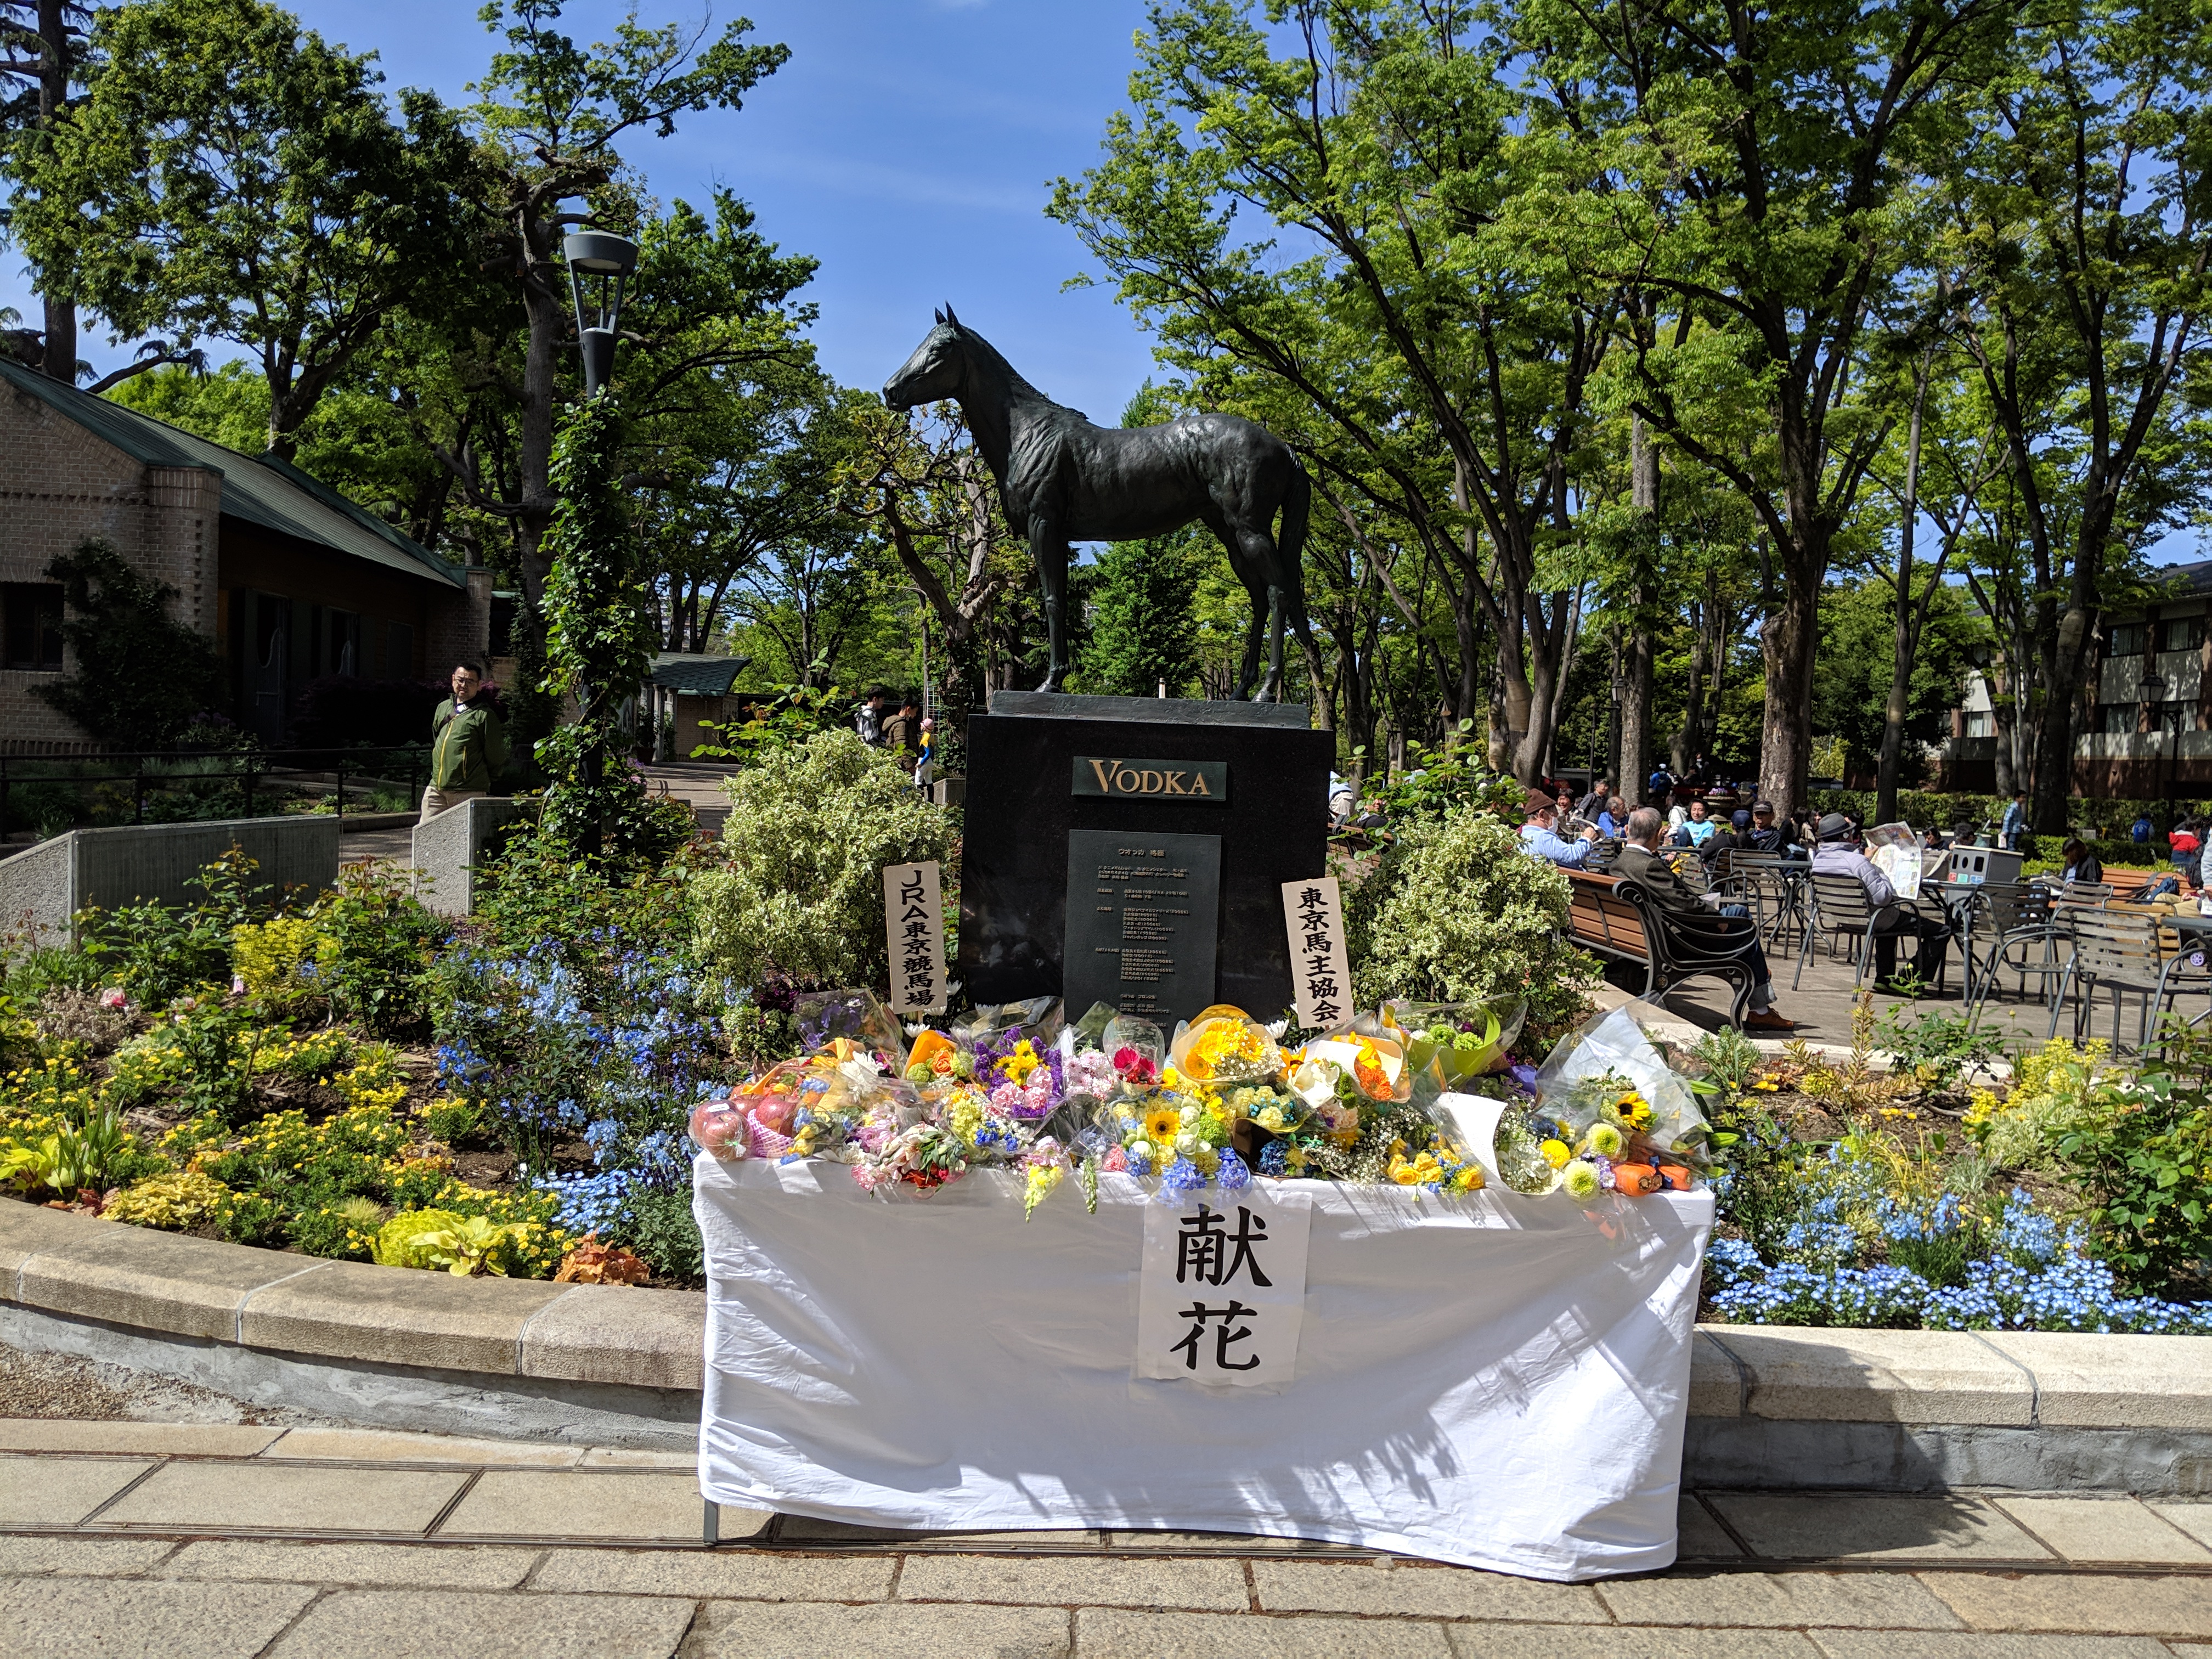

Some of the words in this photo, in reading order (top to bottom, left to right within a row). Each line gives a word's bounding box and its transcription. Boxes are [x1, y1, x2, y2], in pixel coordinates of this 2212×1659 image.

[1088, 759, 1211, 795] VODKA
[900, 870, 936, 1007] JRA東京競馬場
[1296, 887, 1342, 1023] 東京馬主協会
[1170, 1203, 1273, 1370] 献花
